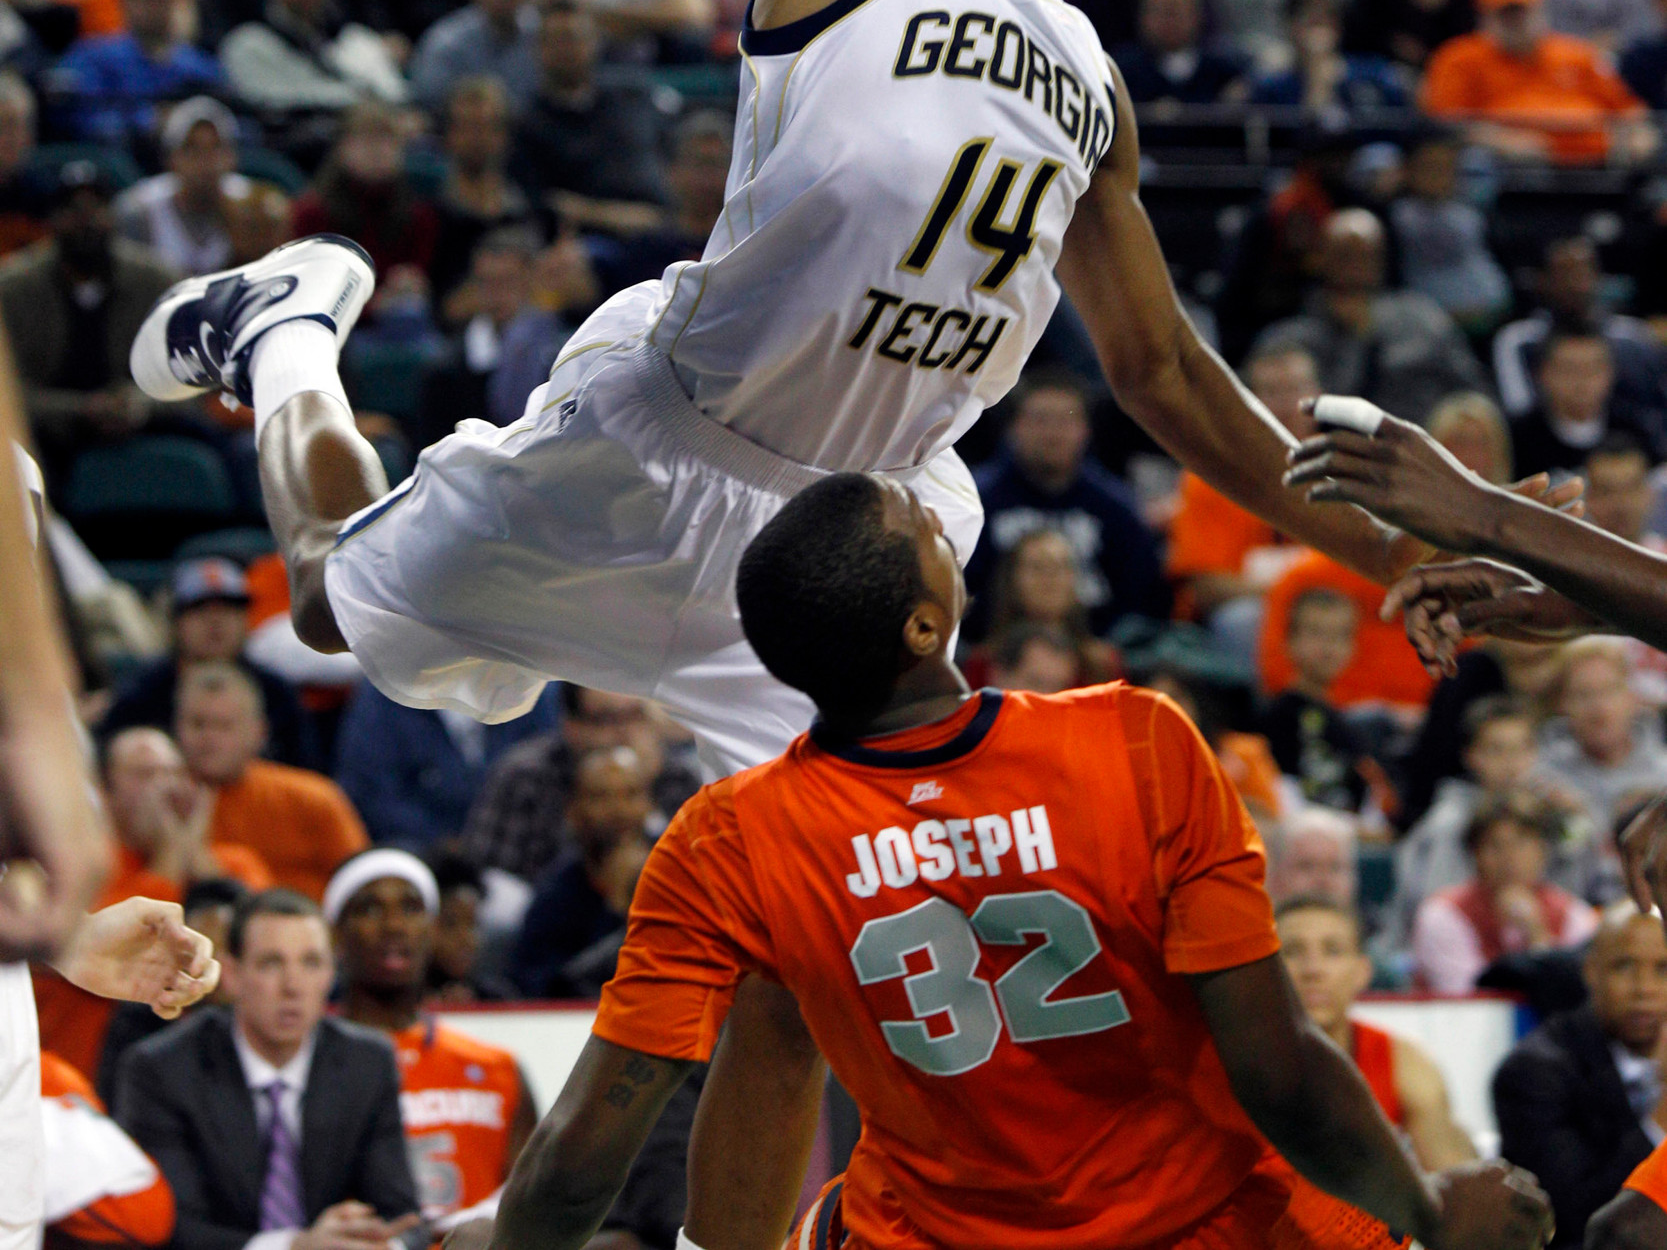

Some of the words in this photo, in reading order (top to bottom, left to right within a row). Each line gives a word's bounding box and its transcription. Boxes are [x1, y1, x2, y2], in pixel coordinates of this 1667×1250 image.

[892, 9, 1109, 176] GEORGIA
[897, 137, 1066, 294] 14
[849, 286, 1010, 376] TECH
[846, 804, 1058, 898] JOSEPH
[850, 889, 1132, 1076] 32
